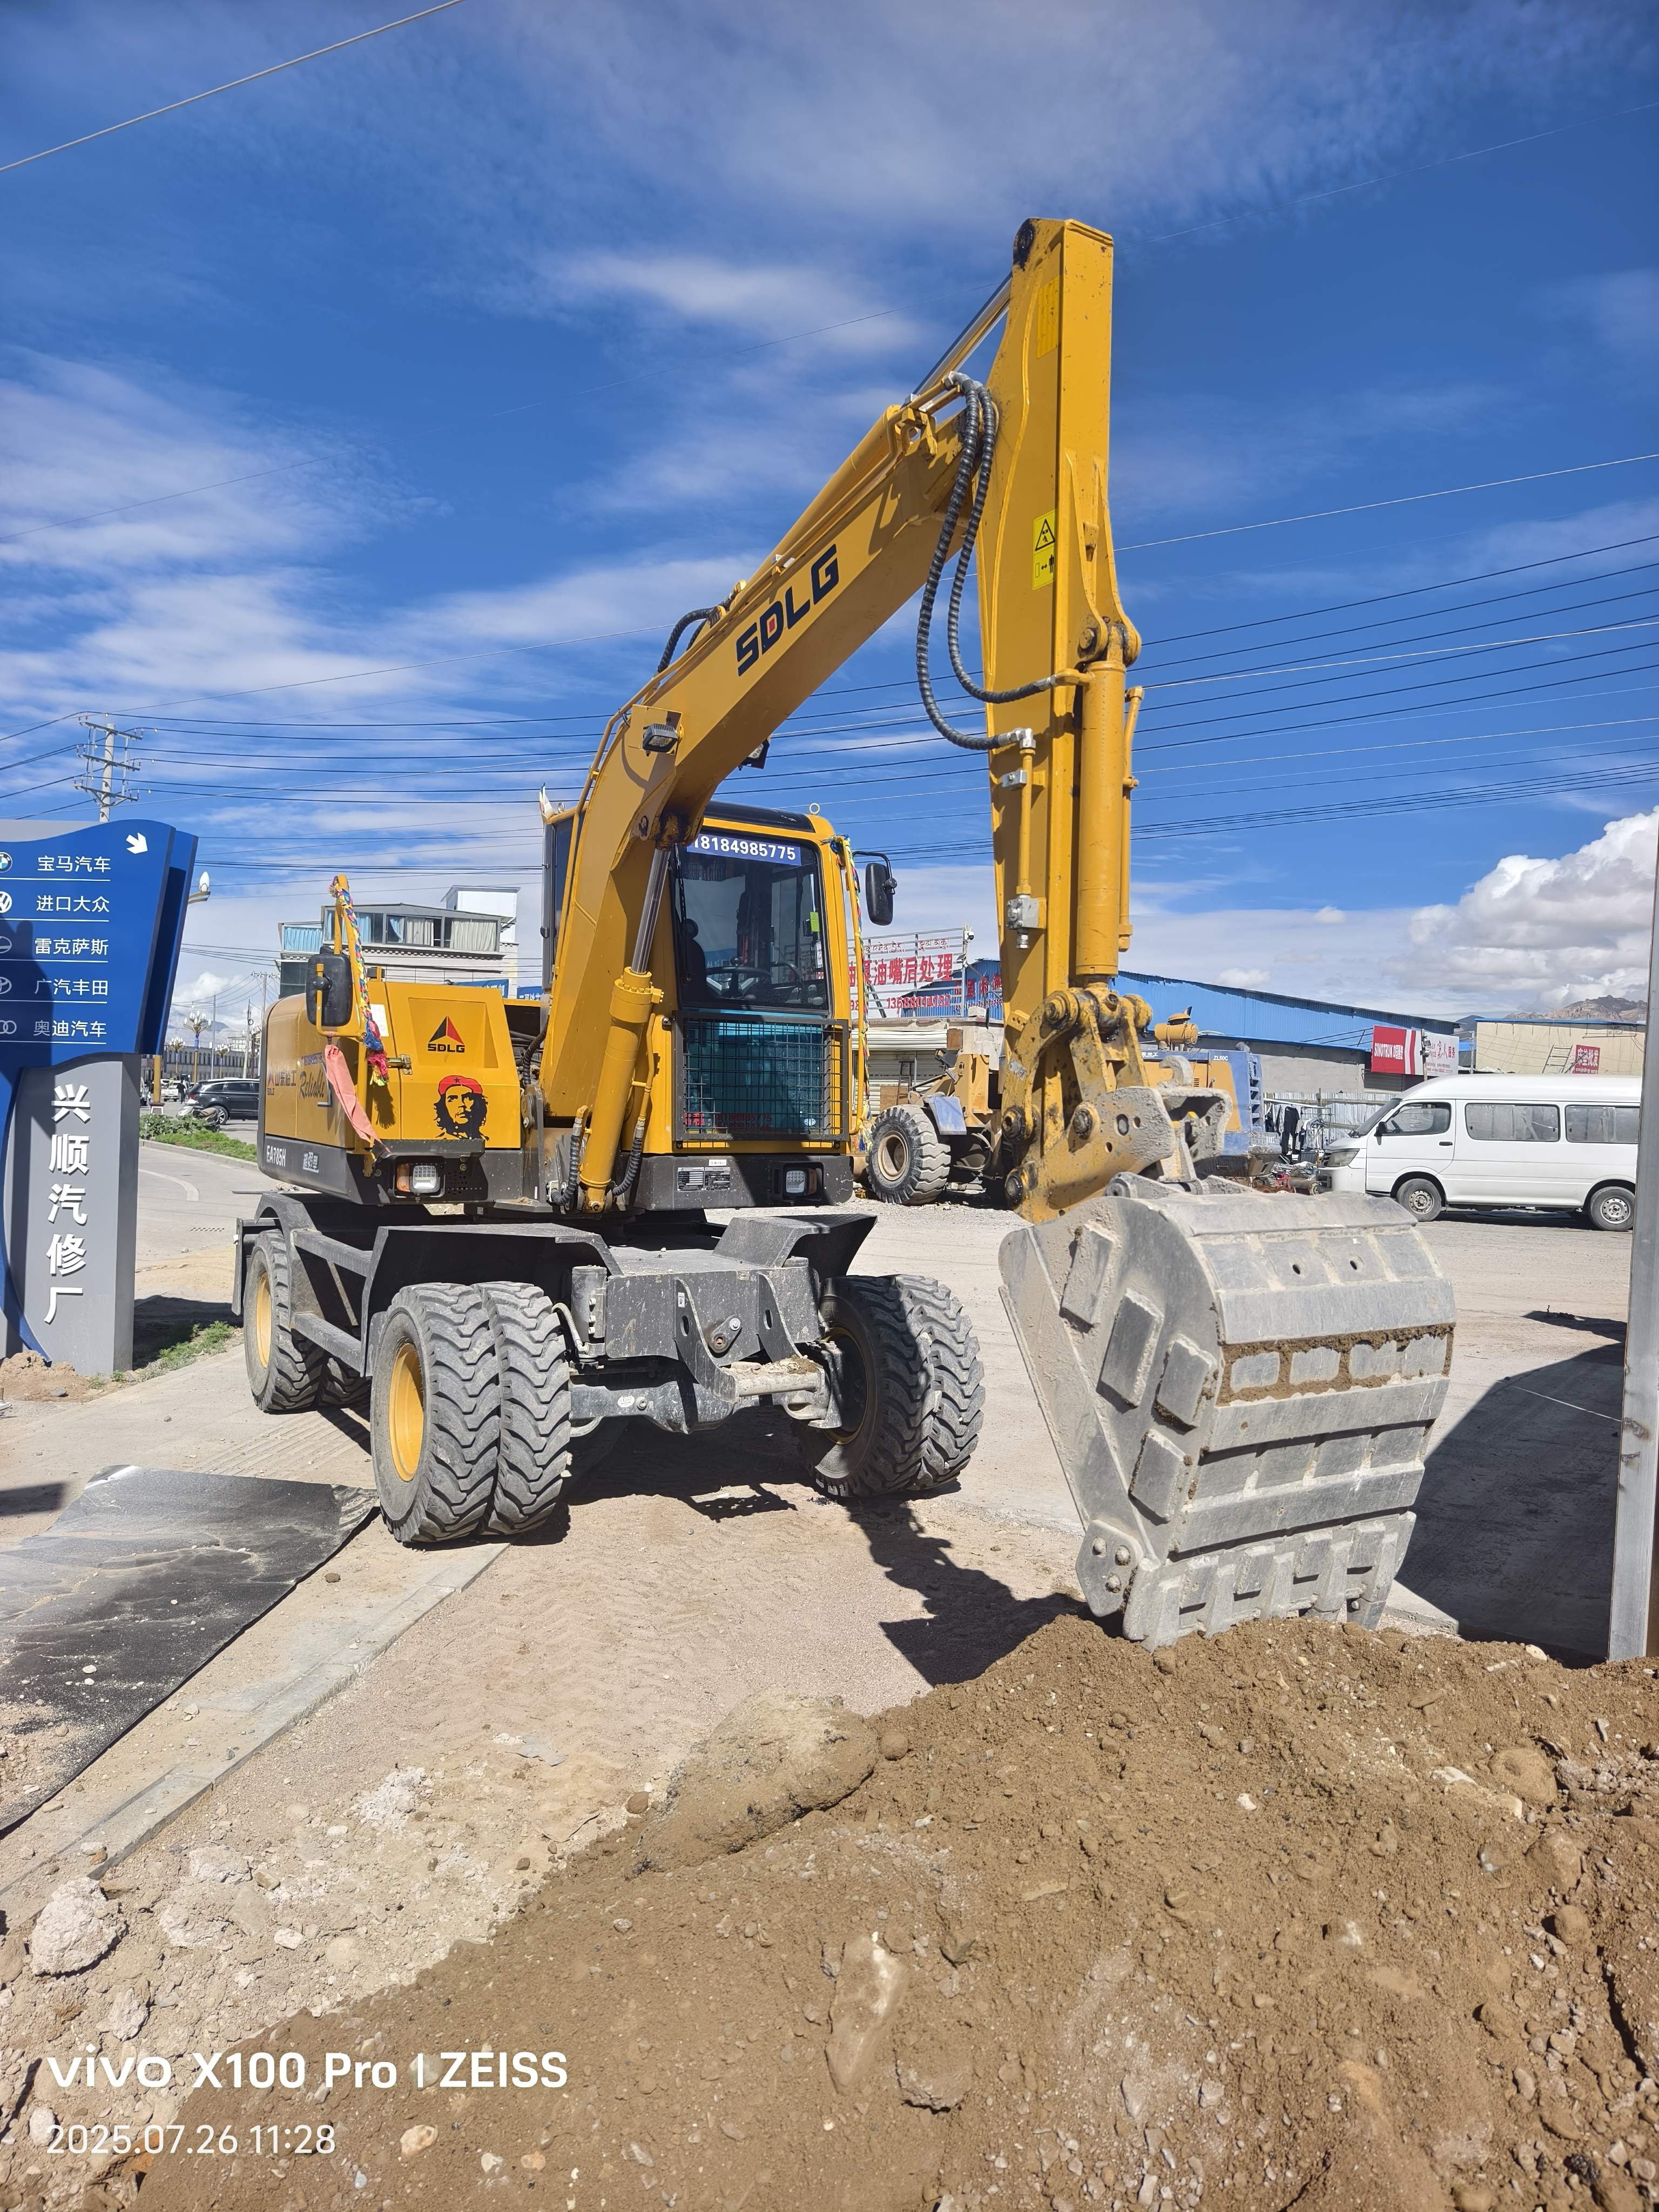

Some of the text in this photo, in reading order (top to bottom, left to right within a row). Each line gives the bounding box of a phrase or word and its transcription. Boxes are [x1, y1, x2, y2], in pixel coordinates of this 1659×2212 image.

[736, 543, 839, 676] SDLG
[694, 835, 795, 860] 18184985775
[37, 855, 111, 873] 宝马汽车
[36, 895, 110, 913] 进口大众
[35, 938, 109, 955] 雷克萨斯
[34, 978, 109, 996] 广汽丰田
[33, 1020, 107, 1037] 奥迪汽车
[427, 1043, 466, 1053] SDLG
[1374, 1042, 1393, 1058] SINOTRUK
[300, 1068, 325, 1100] Reliable
[266, 1145, 286, 1166] EA785H
[44, 1083, 91, 1324] 兴顺汽修厂
